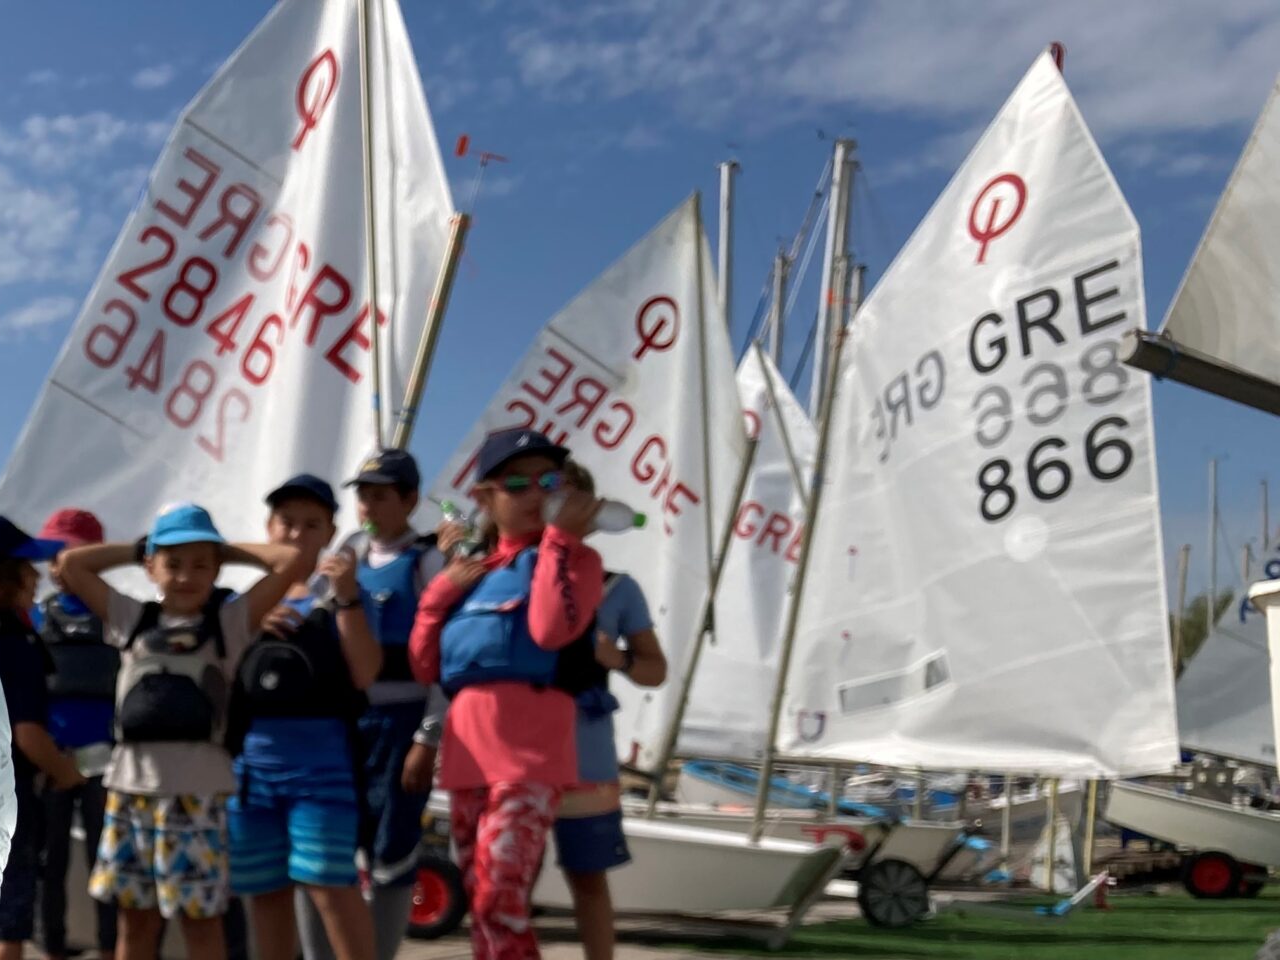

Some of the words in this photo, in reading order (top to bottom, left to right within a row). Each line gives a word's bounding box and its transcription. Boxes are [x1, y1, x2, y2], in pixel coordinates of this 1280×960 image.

[116, 224, 284, 387] 2846
[968, 260, 1129, 376] GRE
[977, 416, 1134, 522] 866
